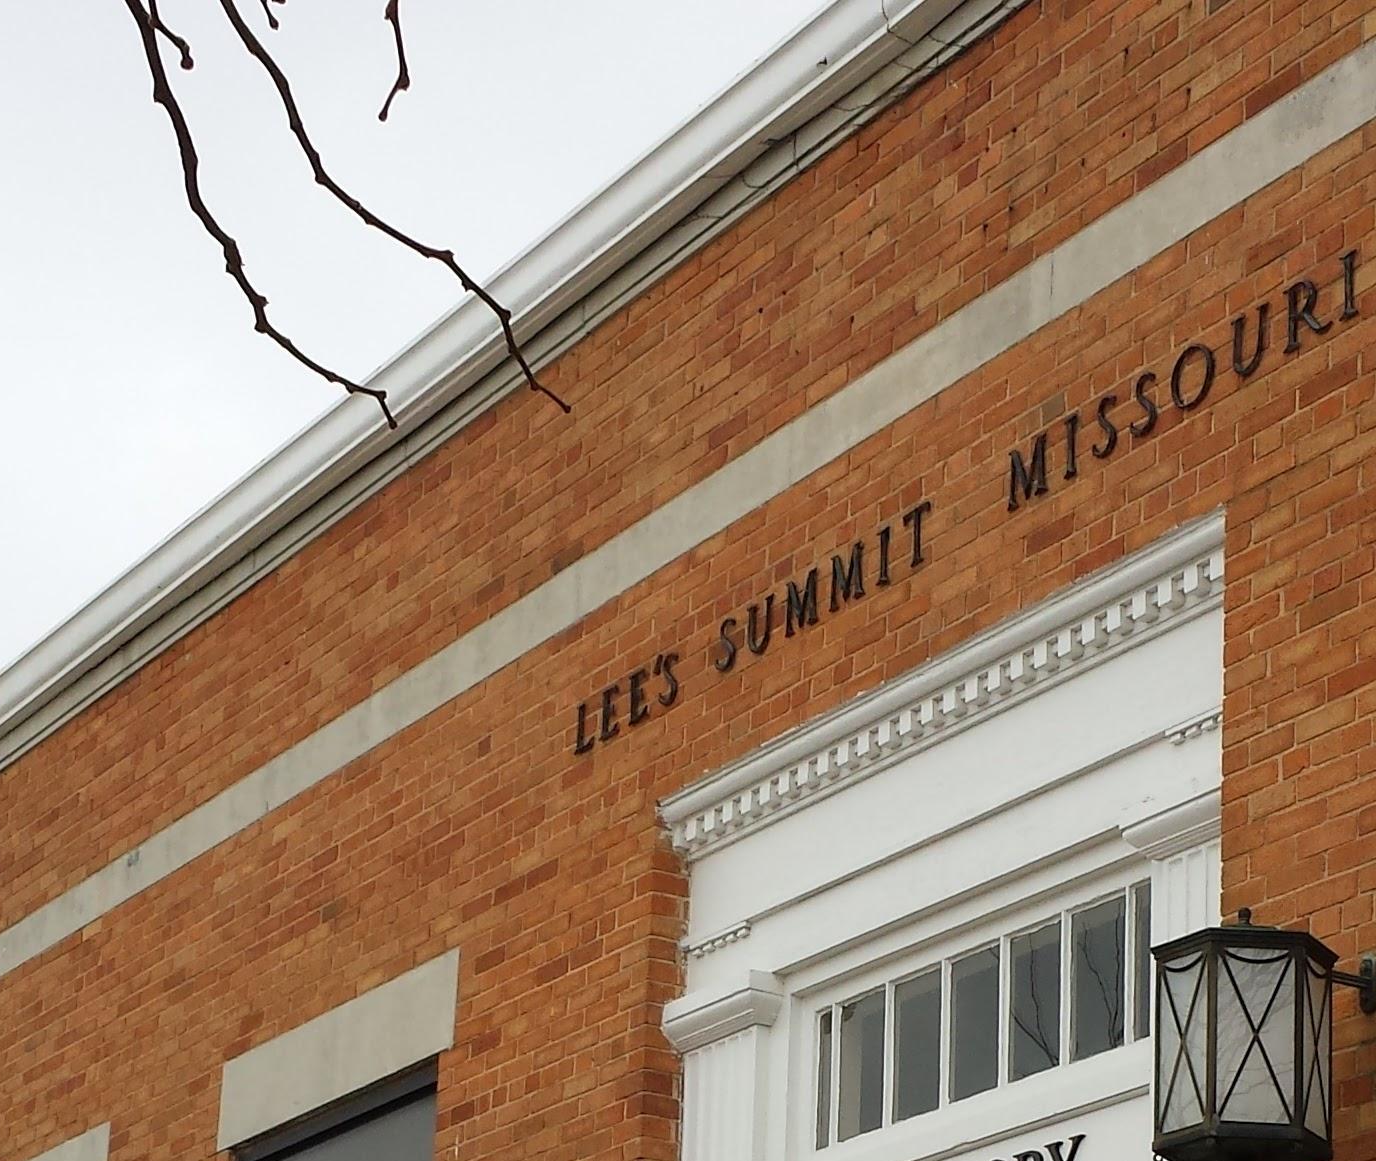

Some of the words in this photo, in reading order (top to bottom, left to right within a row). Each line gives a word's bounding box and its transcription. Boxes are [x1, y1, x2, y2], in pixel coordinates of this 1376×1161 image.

[573, 652, 680, 757] LEE'S
[710, 501, 932, 676] SUMMIT
[1007, 249, 1360, 514] MISSOURI
